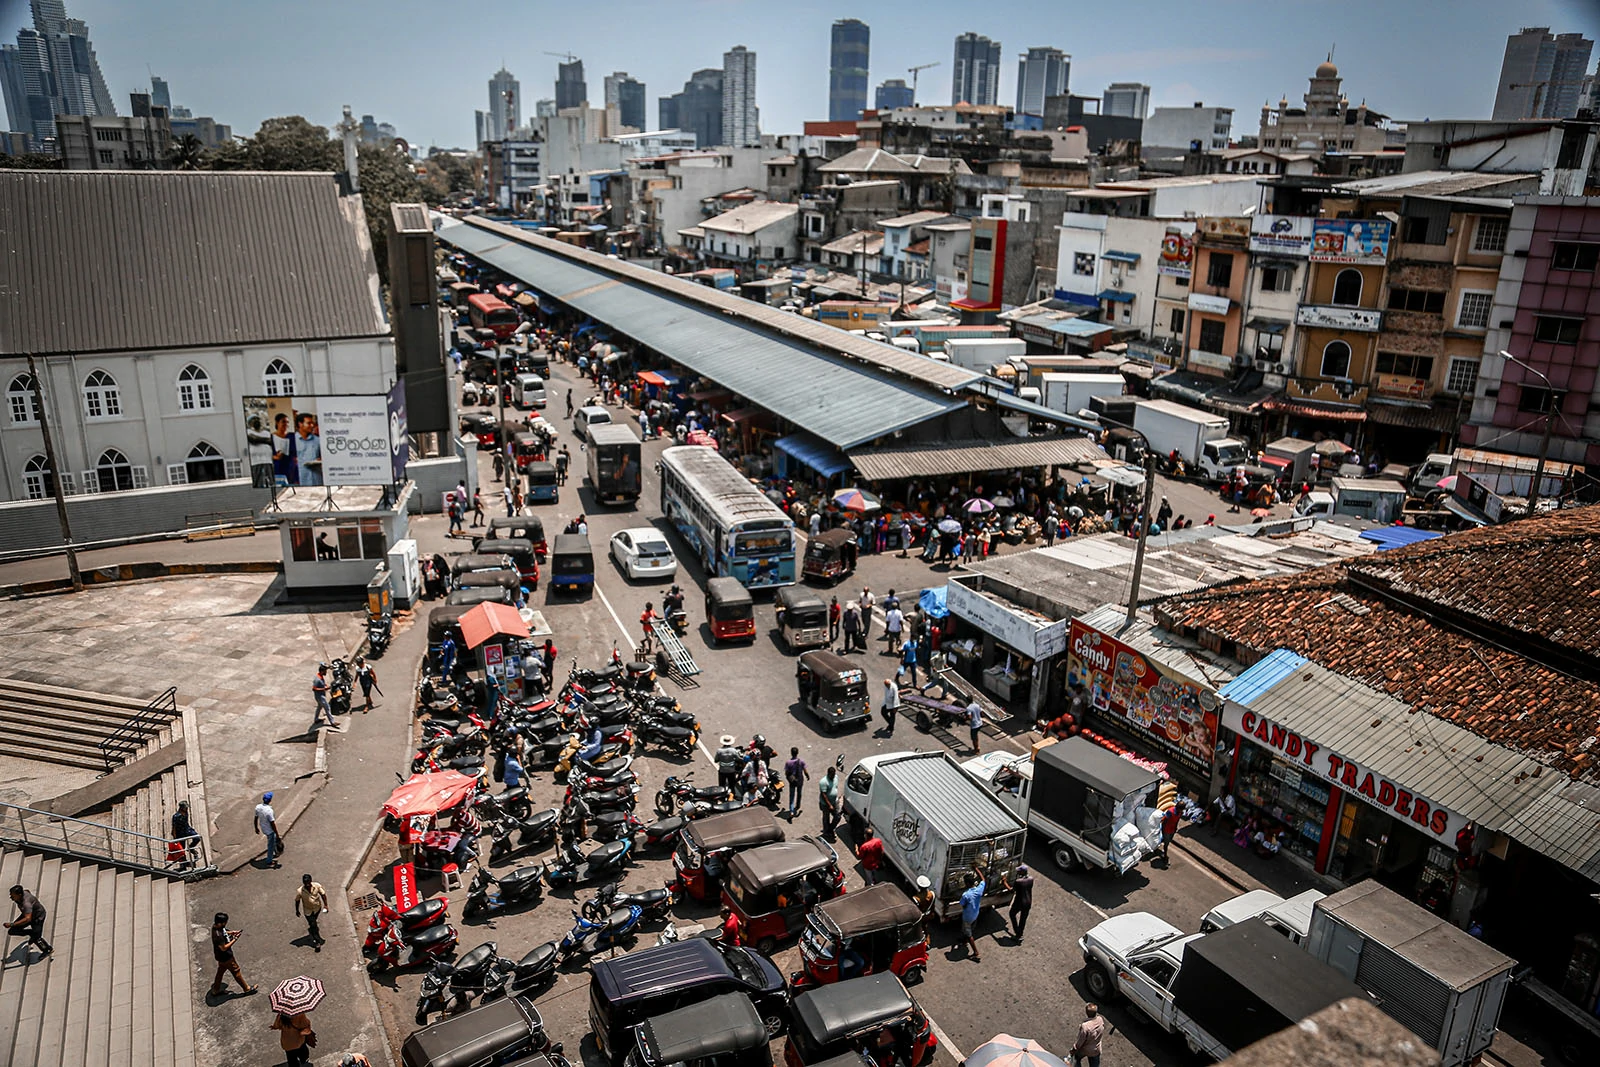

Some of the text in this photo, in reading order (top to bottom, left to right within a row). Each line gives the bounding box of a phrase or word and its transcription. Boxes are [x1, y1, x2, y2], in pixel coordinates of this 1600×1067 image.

[1075, 637, 1111, 671] Candy
[1241, 711, 1449, 836] CANDY TRADERS
[400, 875, 412, 909] airtel 4G
